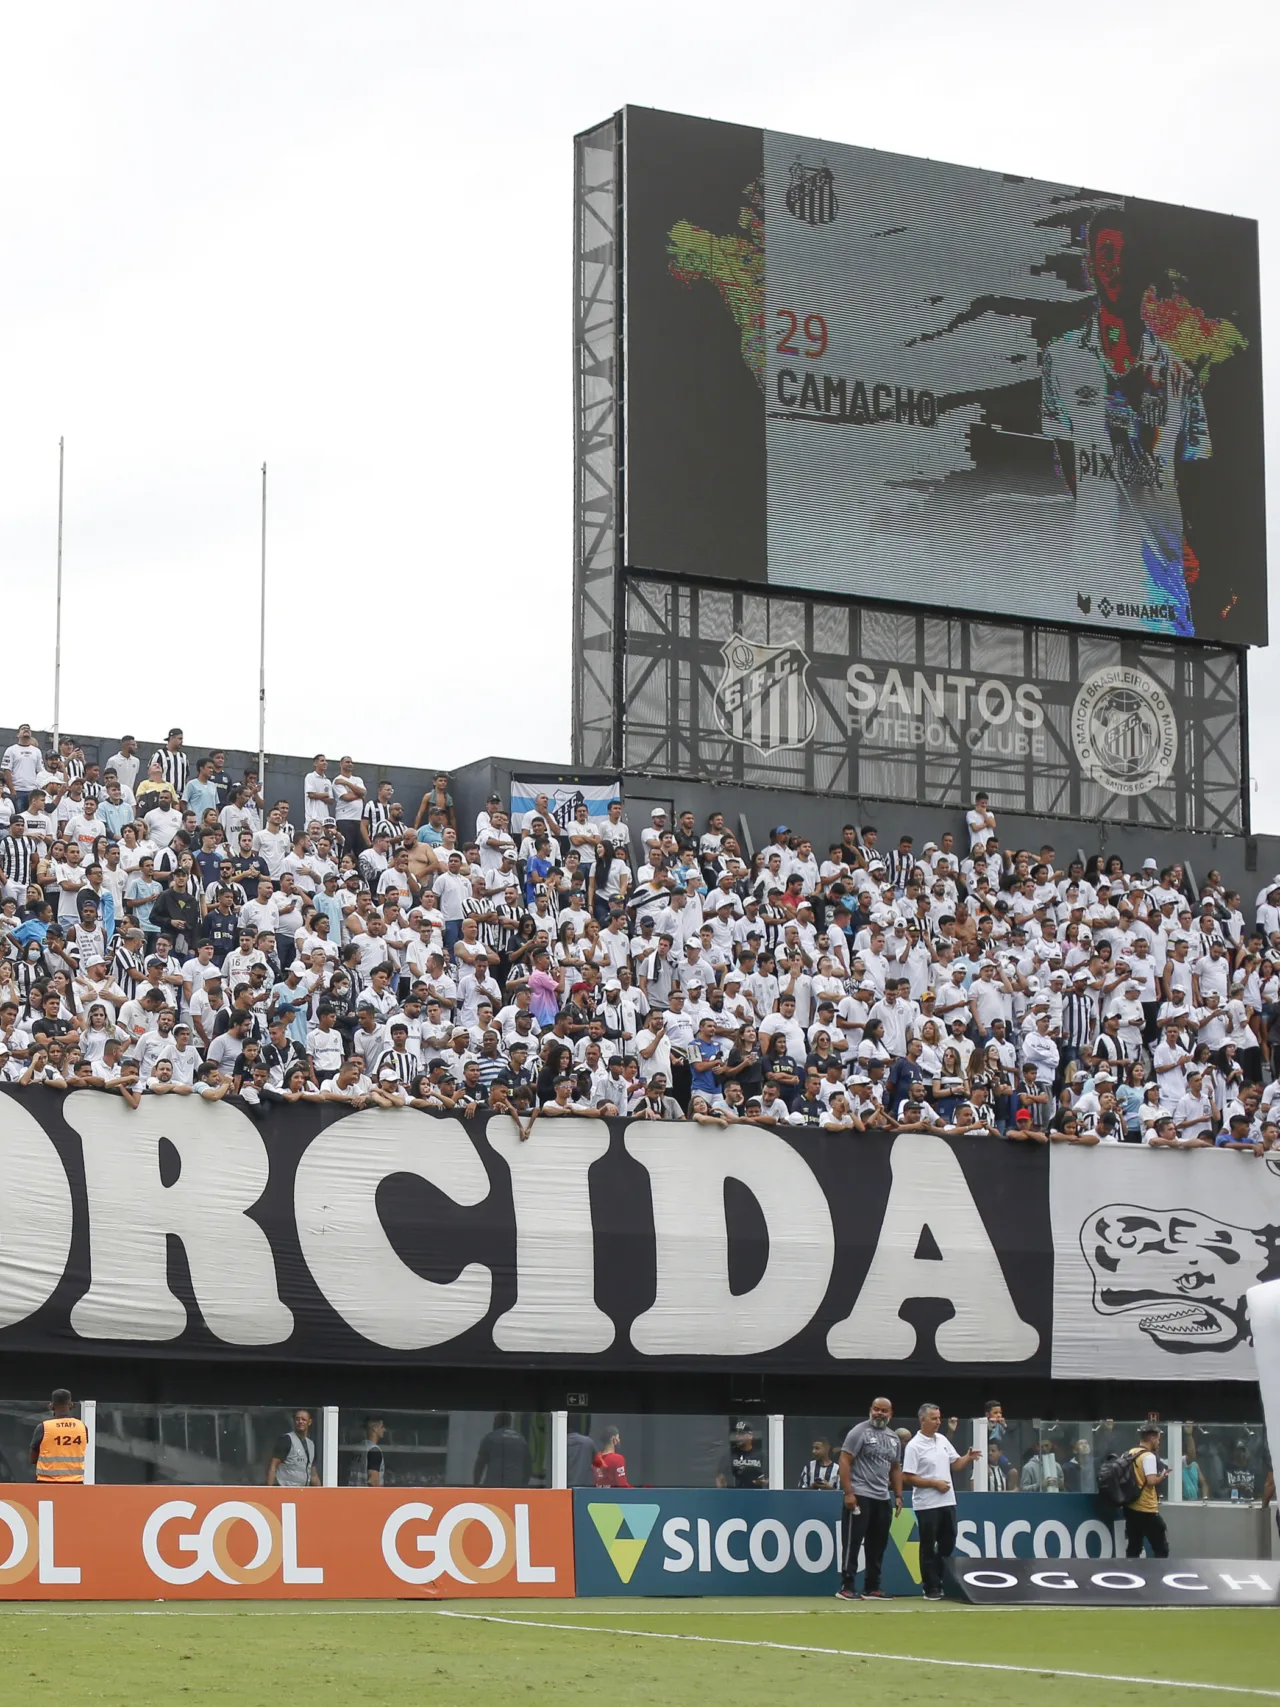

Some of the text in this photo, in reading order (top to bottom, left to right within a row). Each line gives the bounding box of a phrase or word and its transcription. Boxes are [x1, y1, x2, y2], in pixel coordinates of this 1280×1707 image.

[776, 309, 828, 359] 29
[777, 368, 937, 427] CAMACHO
[846, 663, 1045, 729] SANTOS
[1076, 672, 1174, 767] O MAIOR BRASILEIRO DO MUNDO
[847, 712, 1045, 758] FUTEBOL CLUBE
[54, 1435, 82, 1446] 124
[142, 1500, 323, 1585] GOL
[381, 1502, 556, 1584] GOL
[963, 1571, 1274, 1591] OGOCH
